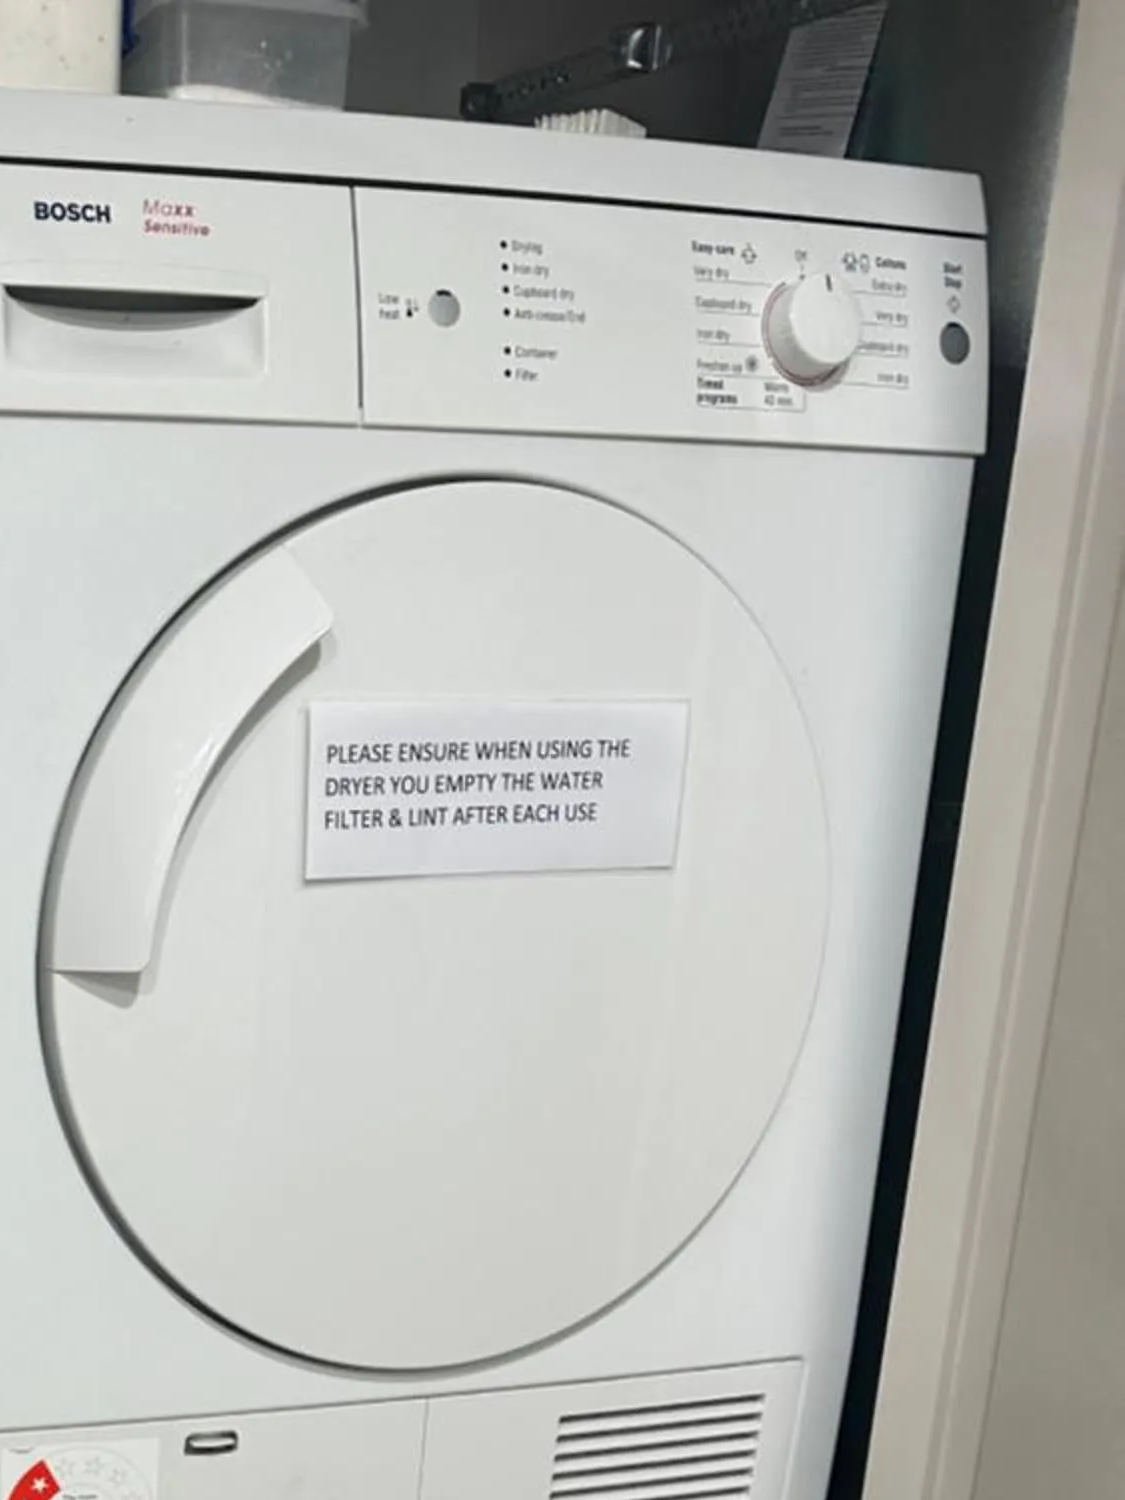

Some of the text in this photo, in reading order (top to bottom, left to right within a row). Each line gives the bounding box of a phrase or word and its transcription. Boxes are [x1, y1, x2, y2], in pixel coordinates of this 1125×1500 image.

[33, 200, 111, 223] BOSCH
[142, 198, 195, 217] Maxx
[143, 218, 211, 237] Sensitive
[326, 738, 631, 765] PLEASE ENSURE WHEN USING THE
[325, 771, 604, 797] DRYER YOU EMPTY THE WATER
[324, 802, 599, 830] FILTER & LINT AFTER EACH USE
